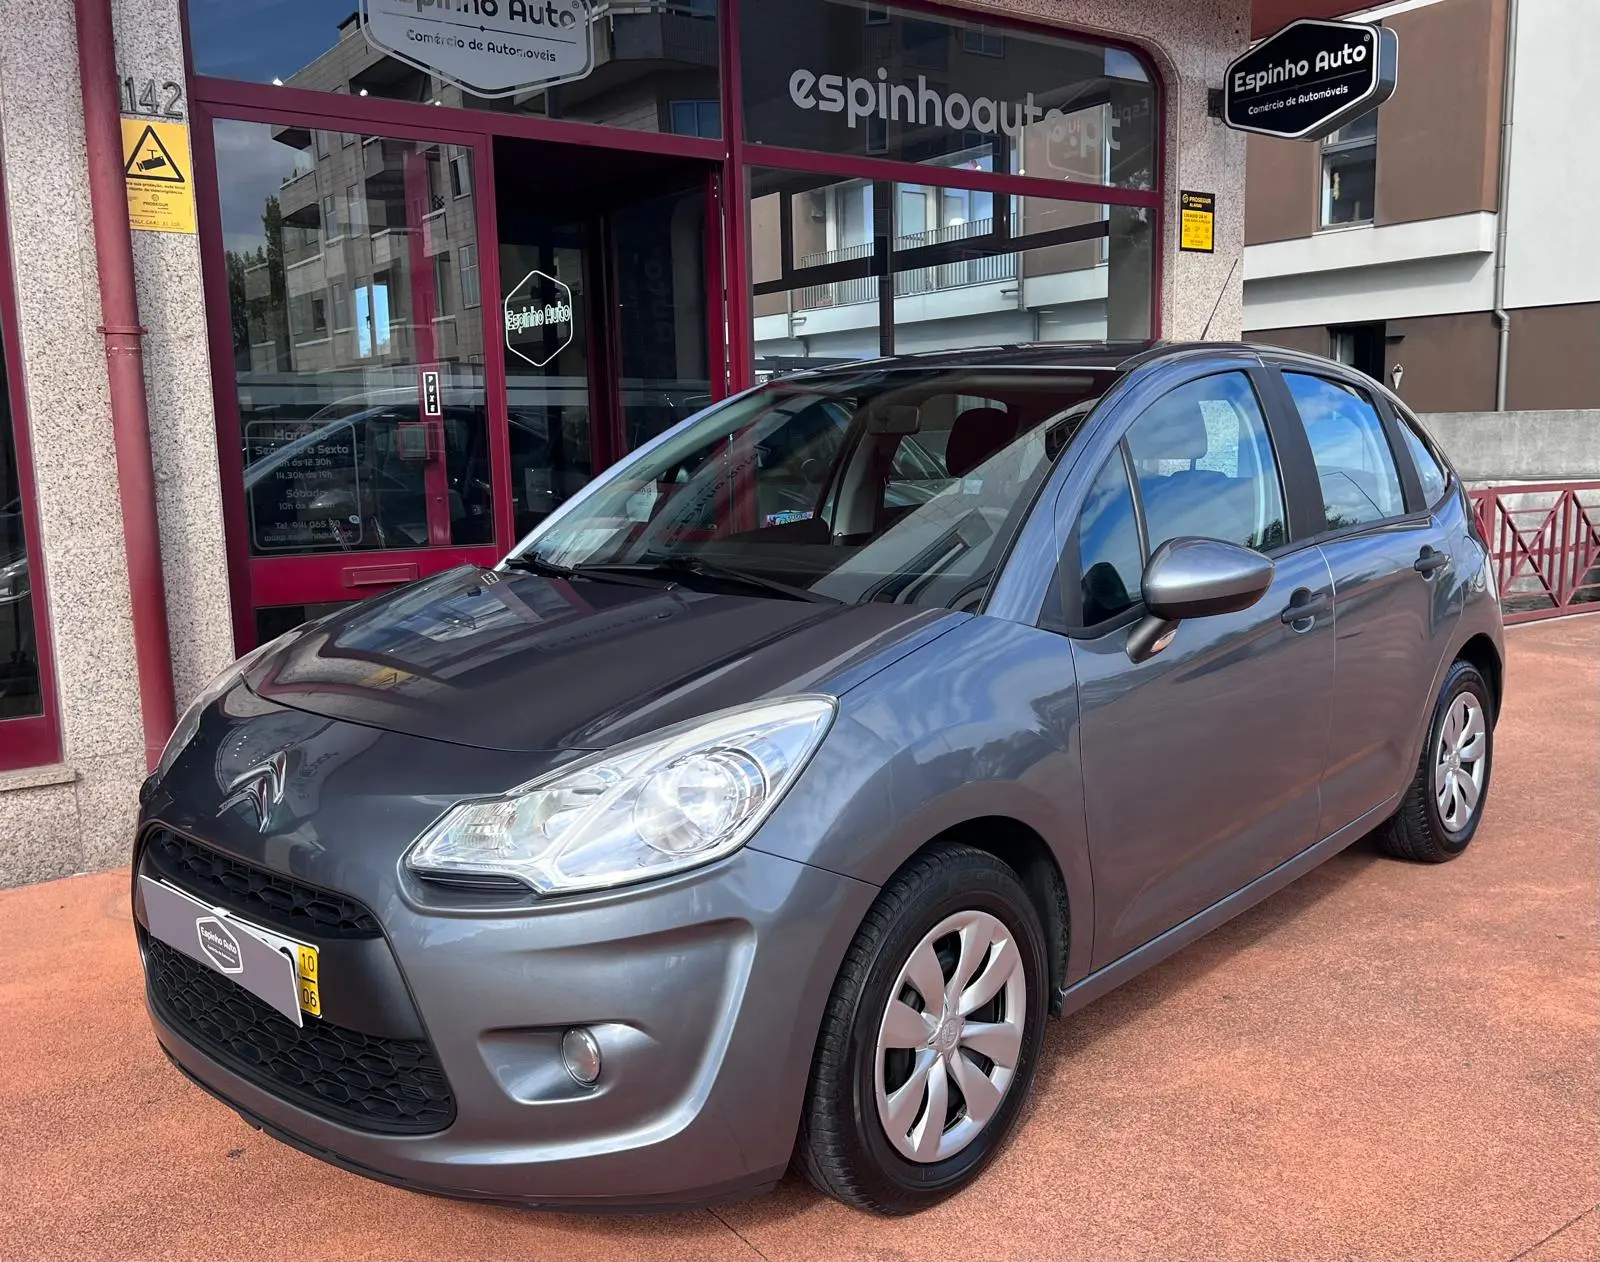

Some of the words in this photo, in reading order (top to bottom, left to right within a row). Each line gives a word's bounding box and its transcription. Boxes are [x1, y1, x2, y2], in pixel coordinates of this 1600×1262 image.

[508, 0, 577, 30] Auto
[407, 29, 464, 49] Comércio
[468, 39, 483, 51] de
[1234, 59, 1309, 93] Espinho
[1315, 43, 1367, 73] Auto
[1248, 98, 1285, 115] Comércio
[1286, 96, 1297, 107] de
[1298, 84, 1349, 104] Automóveis
[507, 306, 544, 334] Espinho
[545, 301, 571, 325] Auto
[427, 375, 436, 412] PUXE
[318, 444, 349, 455] Sexta
[302, 952, 315, 972] 10
[302, 988, 317, 1008] 06
